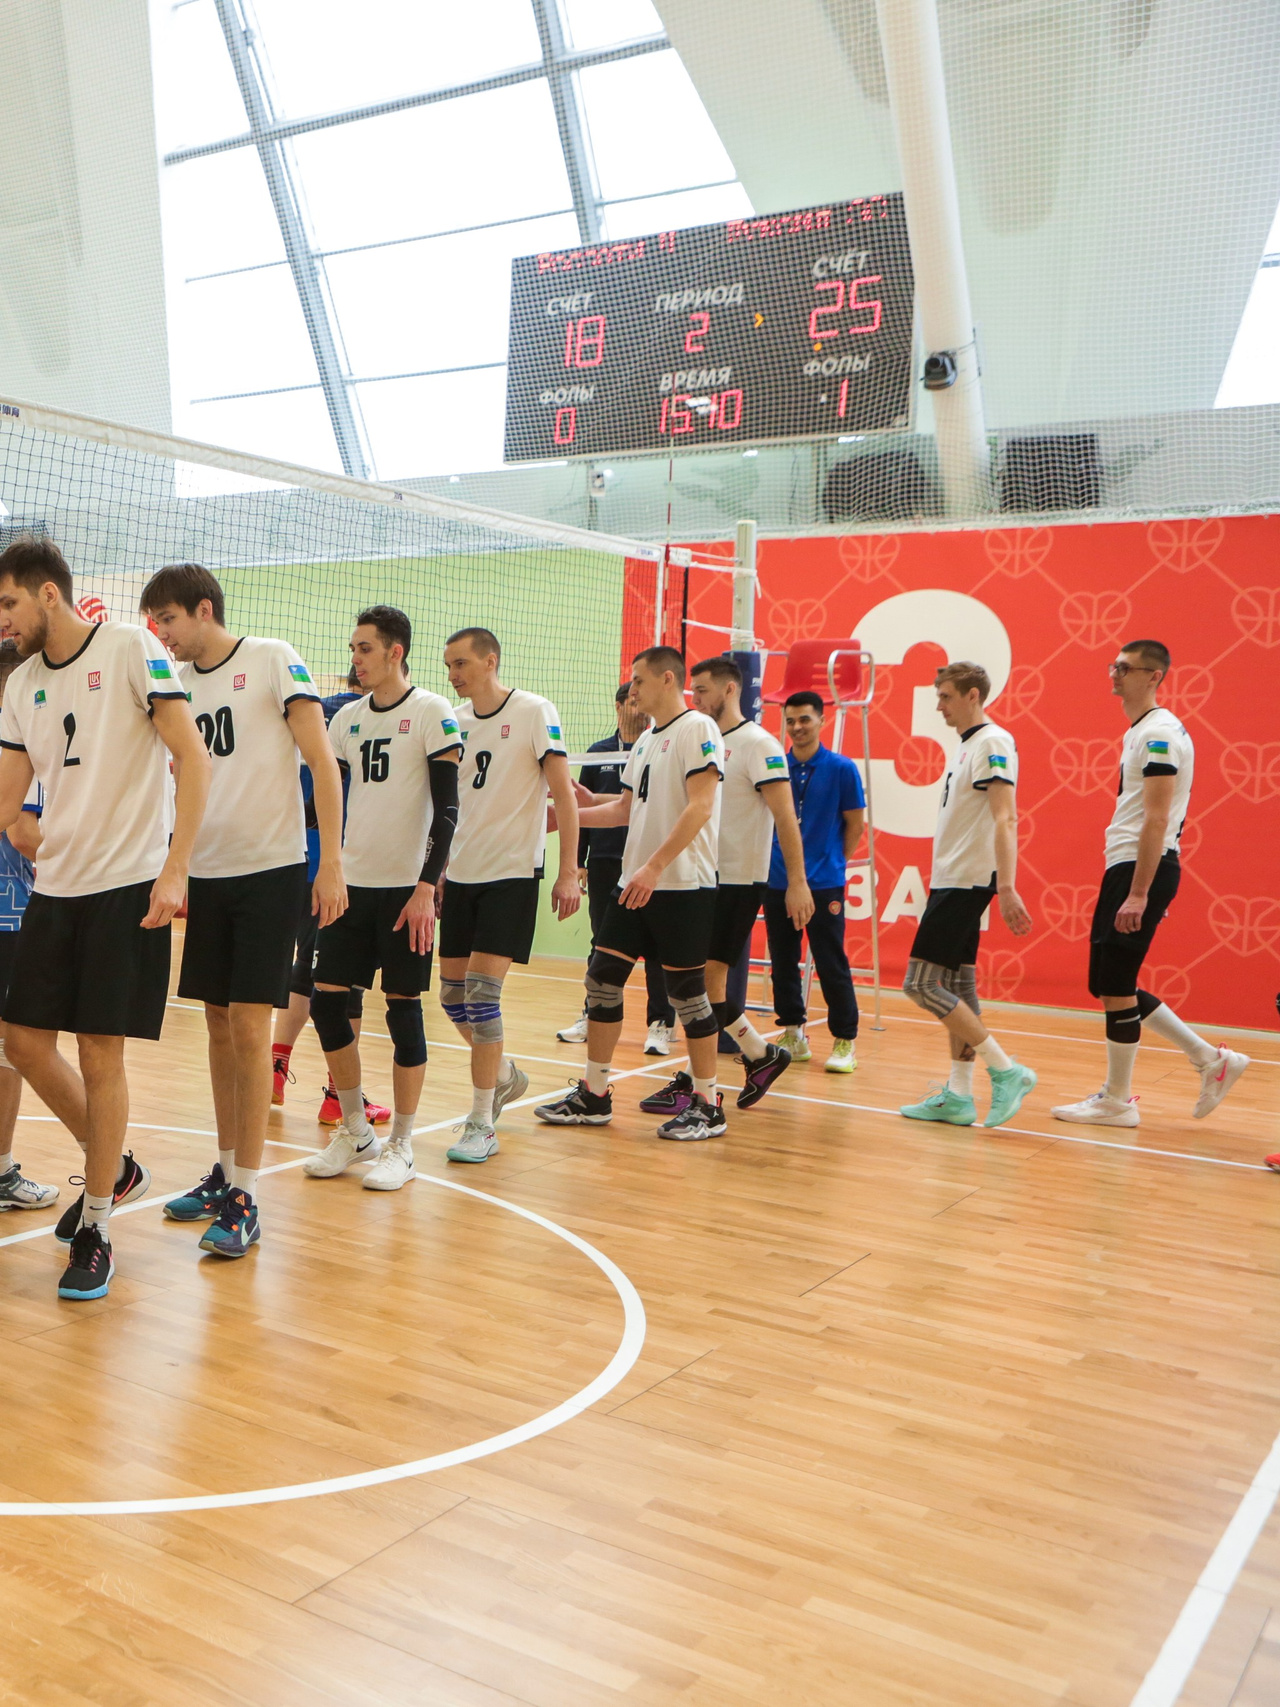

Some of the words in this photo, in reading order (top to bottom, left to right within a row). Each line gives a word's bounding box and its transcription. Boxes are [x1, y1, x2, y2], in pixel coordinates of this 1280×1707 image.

[655, 282, 745, 313] ПЕРИОД
[809, 275, 882, 339] 25
[564, 314, 605, 368] 18
[685, 312, 710, 353] 2
[659, 366, 733, 392] ВРЕМЯ
[803, 353, 871, 377] ФОЛЫ
[539, 384, 595, 405] ФОЛЫ
[838, 378, 849, 418] 1
[554, 407, 577, 444] 0
[849, 588, 1012, 838] 3
[63, 712, 81, 767] 2
[359, 737, 392, 783] 15
[472, 750, 492, 789] 9
[638, 764, 650, 802] 4
